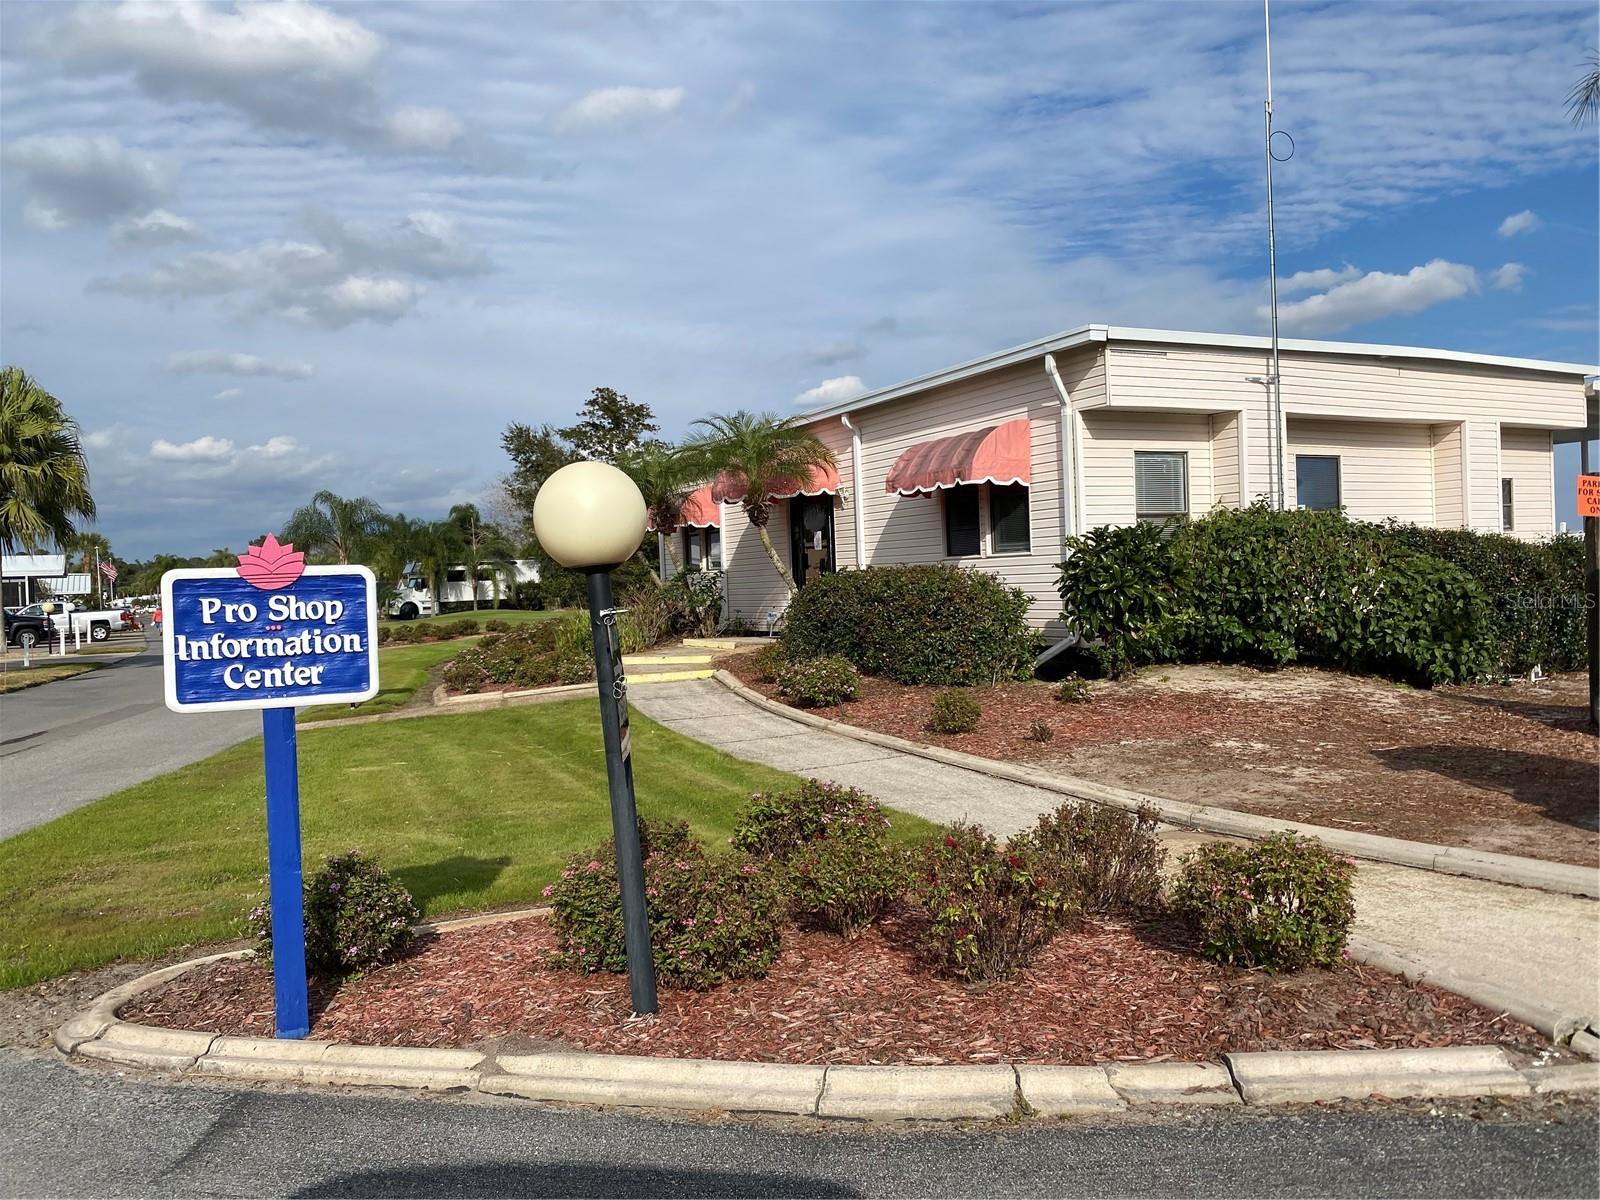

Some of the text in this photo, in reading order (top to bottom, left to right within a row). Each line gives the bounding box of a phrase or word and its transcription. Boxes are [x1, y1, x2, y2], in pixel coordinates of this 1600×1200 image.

[1578, 487, 1594, 496] FOR
[199, 595, 344, 624] Pro Shop
[175, 628, 364, 661] Information
[223, 660, 325, 690] Center
